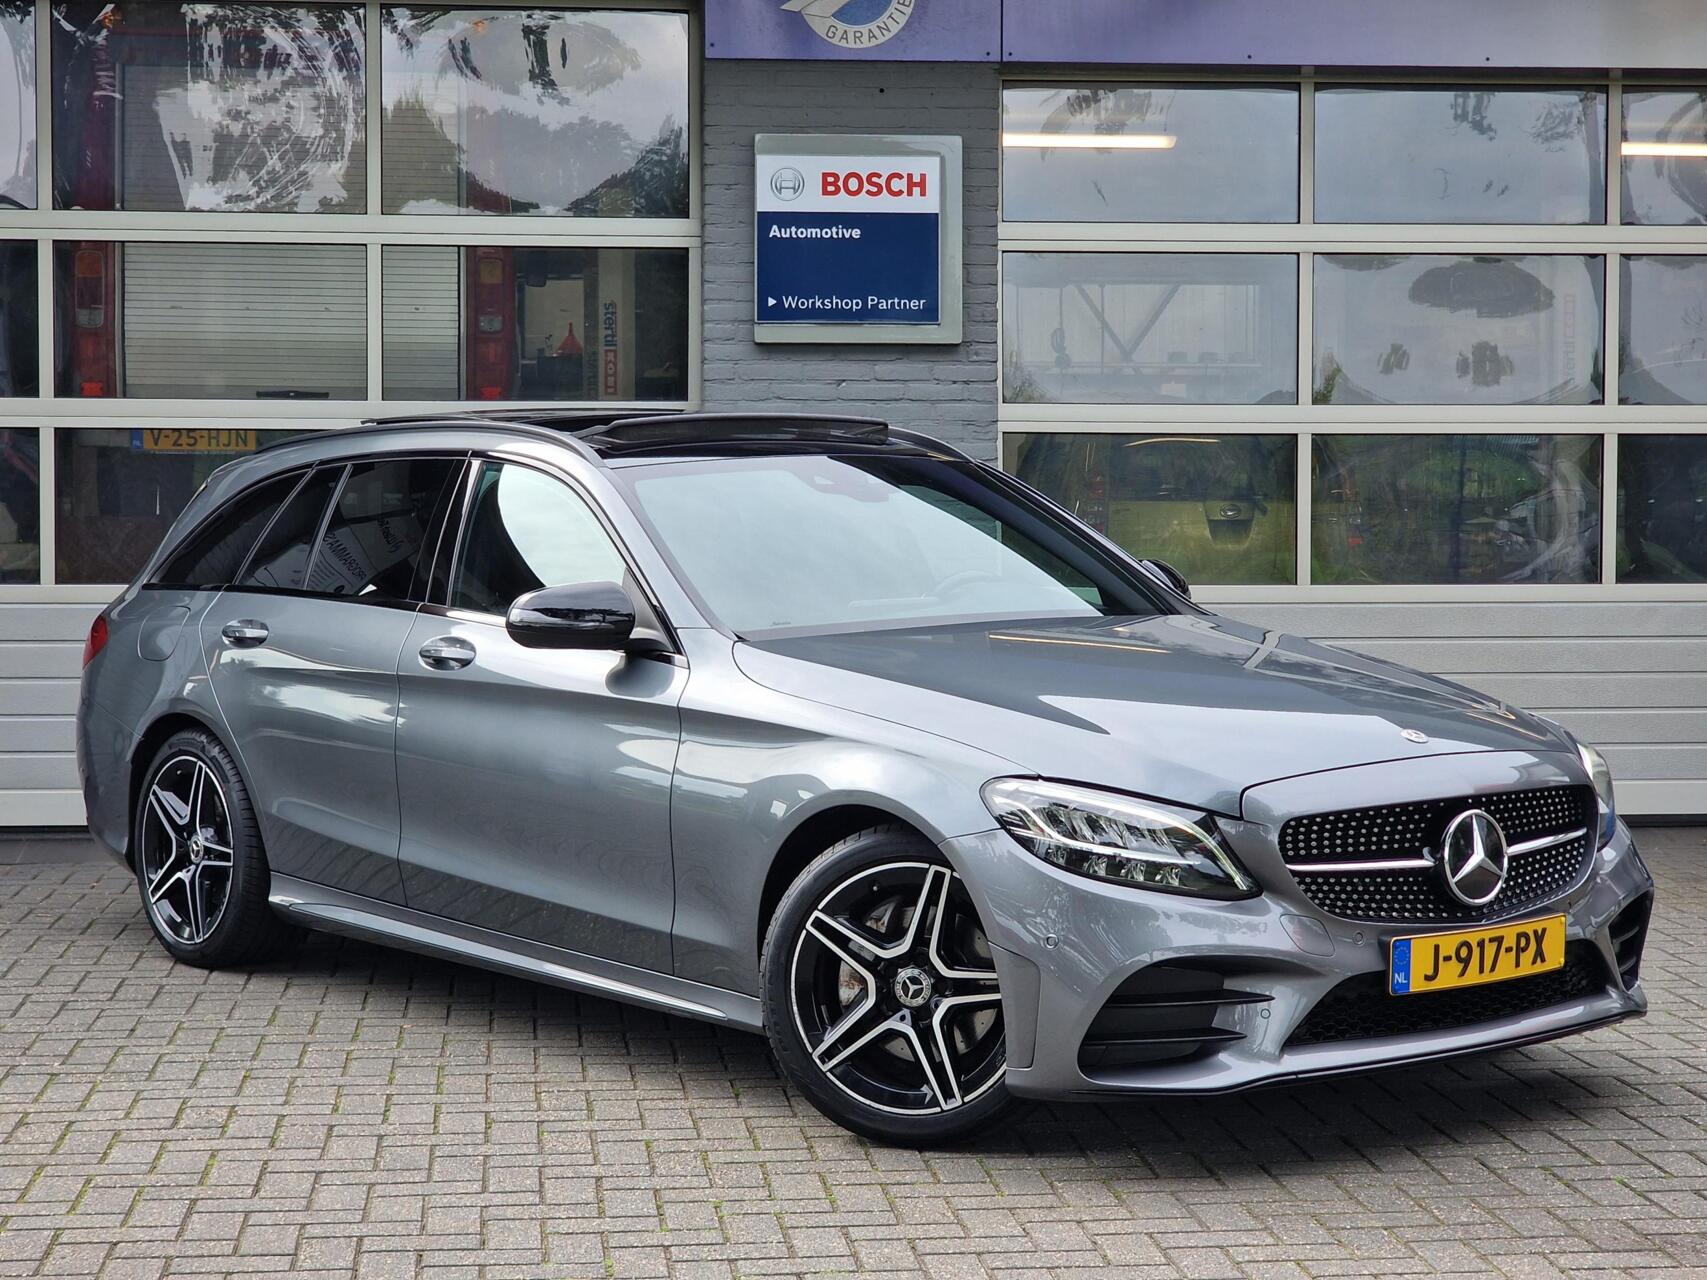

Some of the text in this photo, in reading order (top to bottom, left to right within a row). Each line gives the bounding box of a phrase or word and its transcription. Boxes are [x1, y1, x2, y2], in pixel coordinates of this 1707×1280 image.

[820, 171, 927, 198] BOSCH
[768, 224, 862, 240] Automotive
[782, 295, 927, 312] Workshop Partner
[603, 302, 618, 348] stertil
[150, 429, 248, 448] V-25-HJN
[1423, 927, 1548, 982] J-917-PX
[1394, 973, 1408, 984] NL
